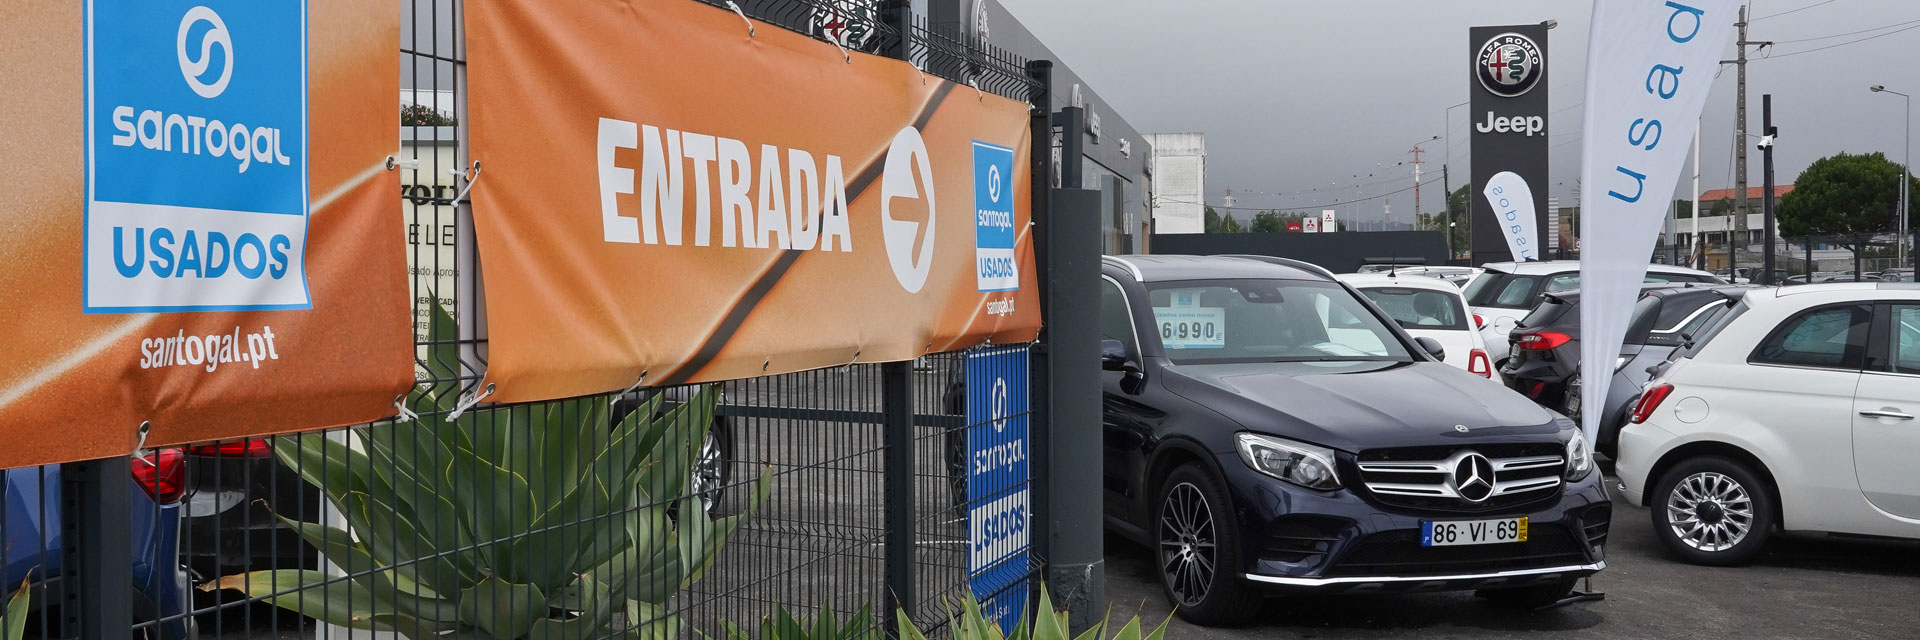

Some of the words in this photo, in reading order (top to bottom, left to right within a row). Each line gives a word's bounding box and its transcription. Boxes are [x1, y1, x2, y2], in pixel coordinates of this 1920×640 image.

[1481, 41, 1501, 66] ALFA
[1506, 37, 1539, 65] ROMEO
[597, 117, 852, 252] ENTRADA
[112, 226, 291, 280] USADOS
[980, 257, 1013, 279] USADOS
[986, 297, 1015, 317] santogal.pt
[140, 326, 279, 373] santogal.pt
